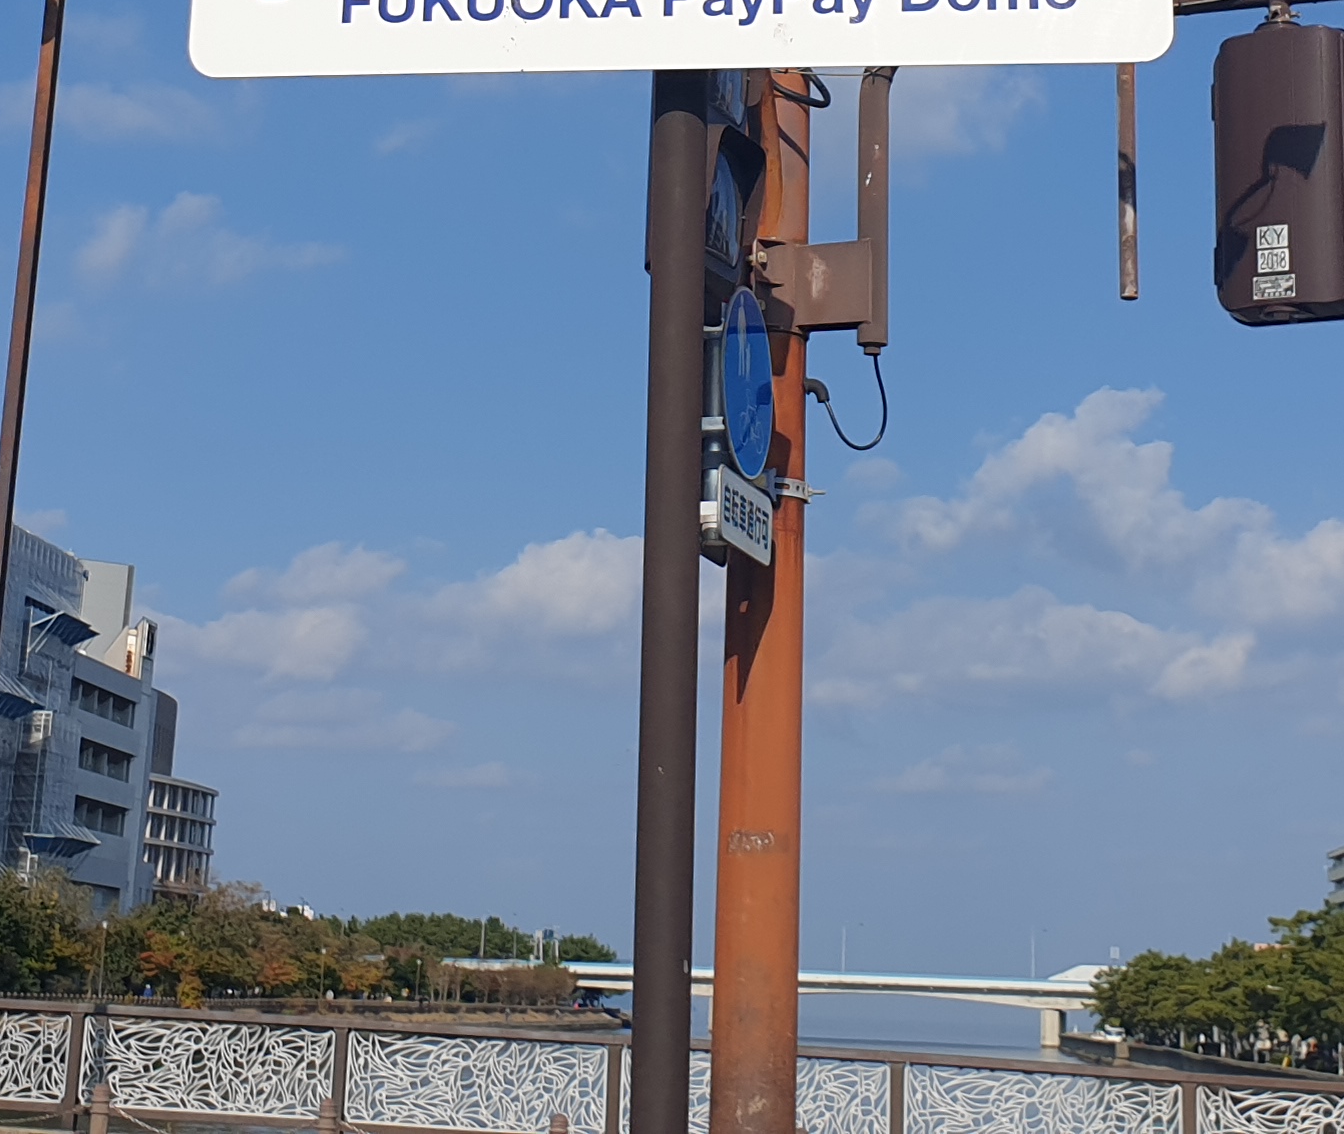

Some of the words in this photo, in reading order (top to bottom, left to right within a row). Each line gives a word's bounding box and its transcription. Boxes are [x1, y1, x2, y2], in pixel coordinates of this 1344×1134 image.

[1259, 227, 1285, 246] KY
[1260, 250, 1287, 270] 2018
[723, 484, 770, 550] 自転車通行可
